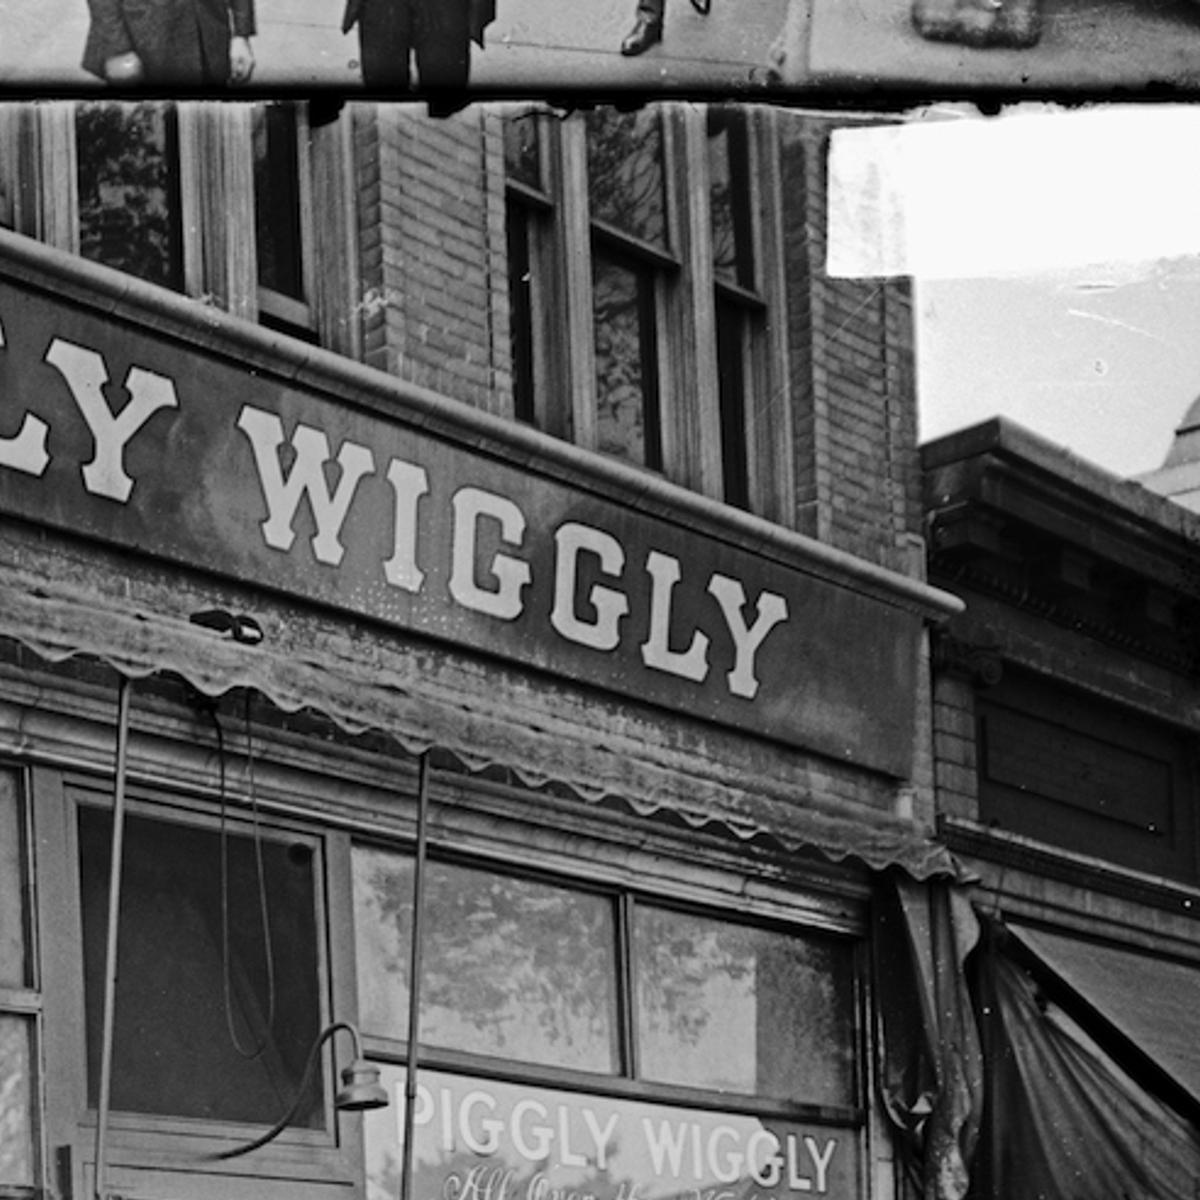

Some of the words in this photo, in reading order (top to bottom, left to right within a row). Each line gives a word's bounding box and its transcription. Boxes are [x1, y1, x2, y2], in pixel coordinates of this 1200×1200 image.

[237, 404, 788, 699] WIGGLY
[395, 1081, 619, 1171] PIGGLY
[642, 1117, 837, 1193] WIGGLY
